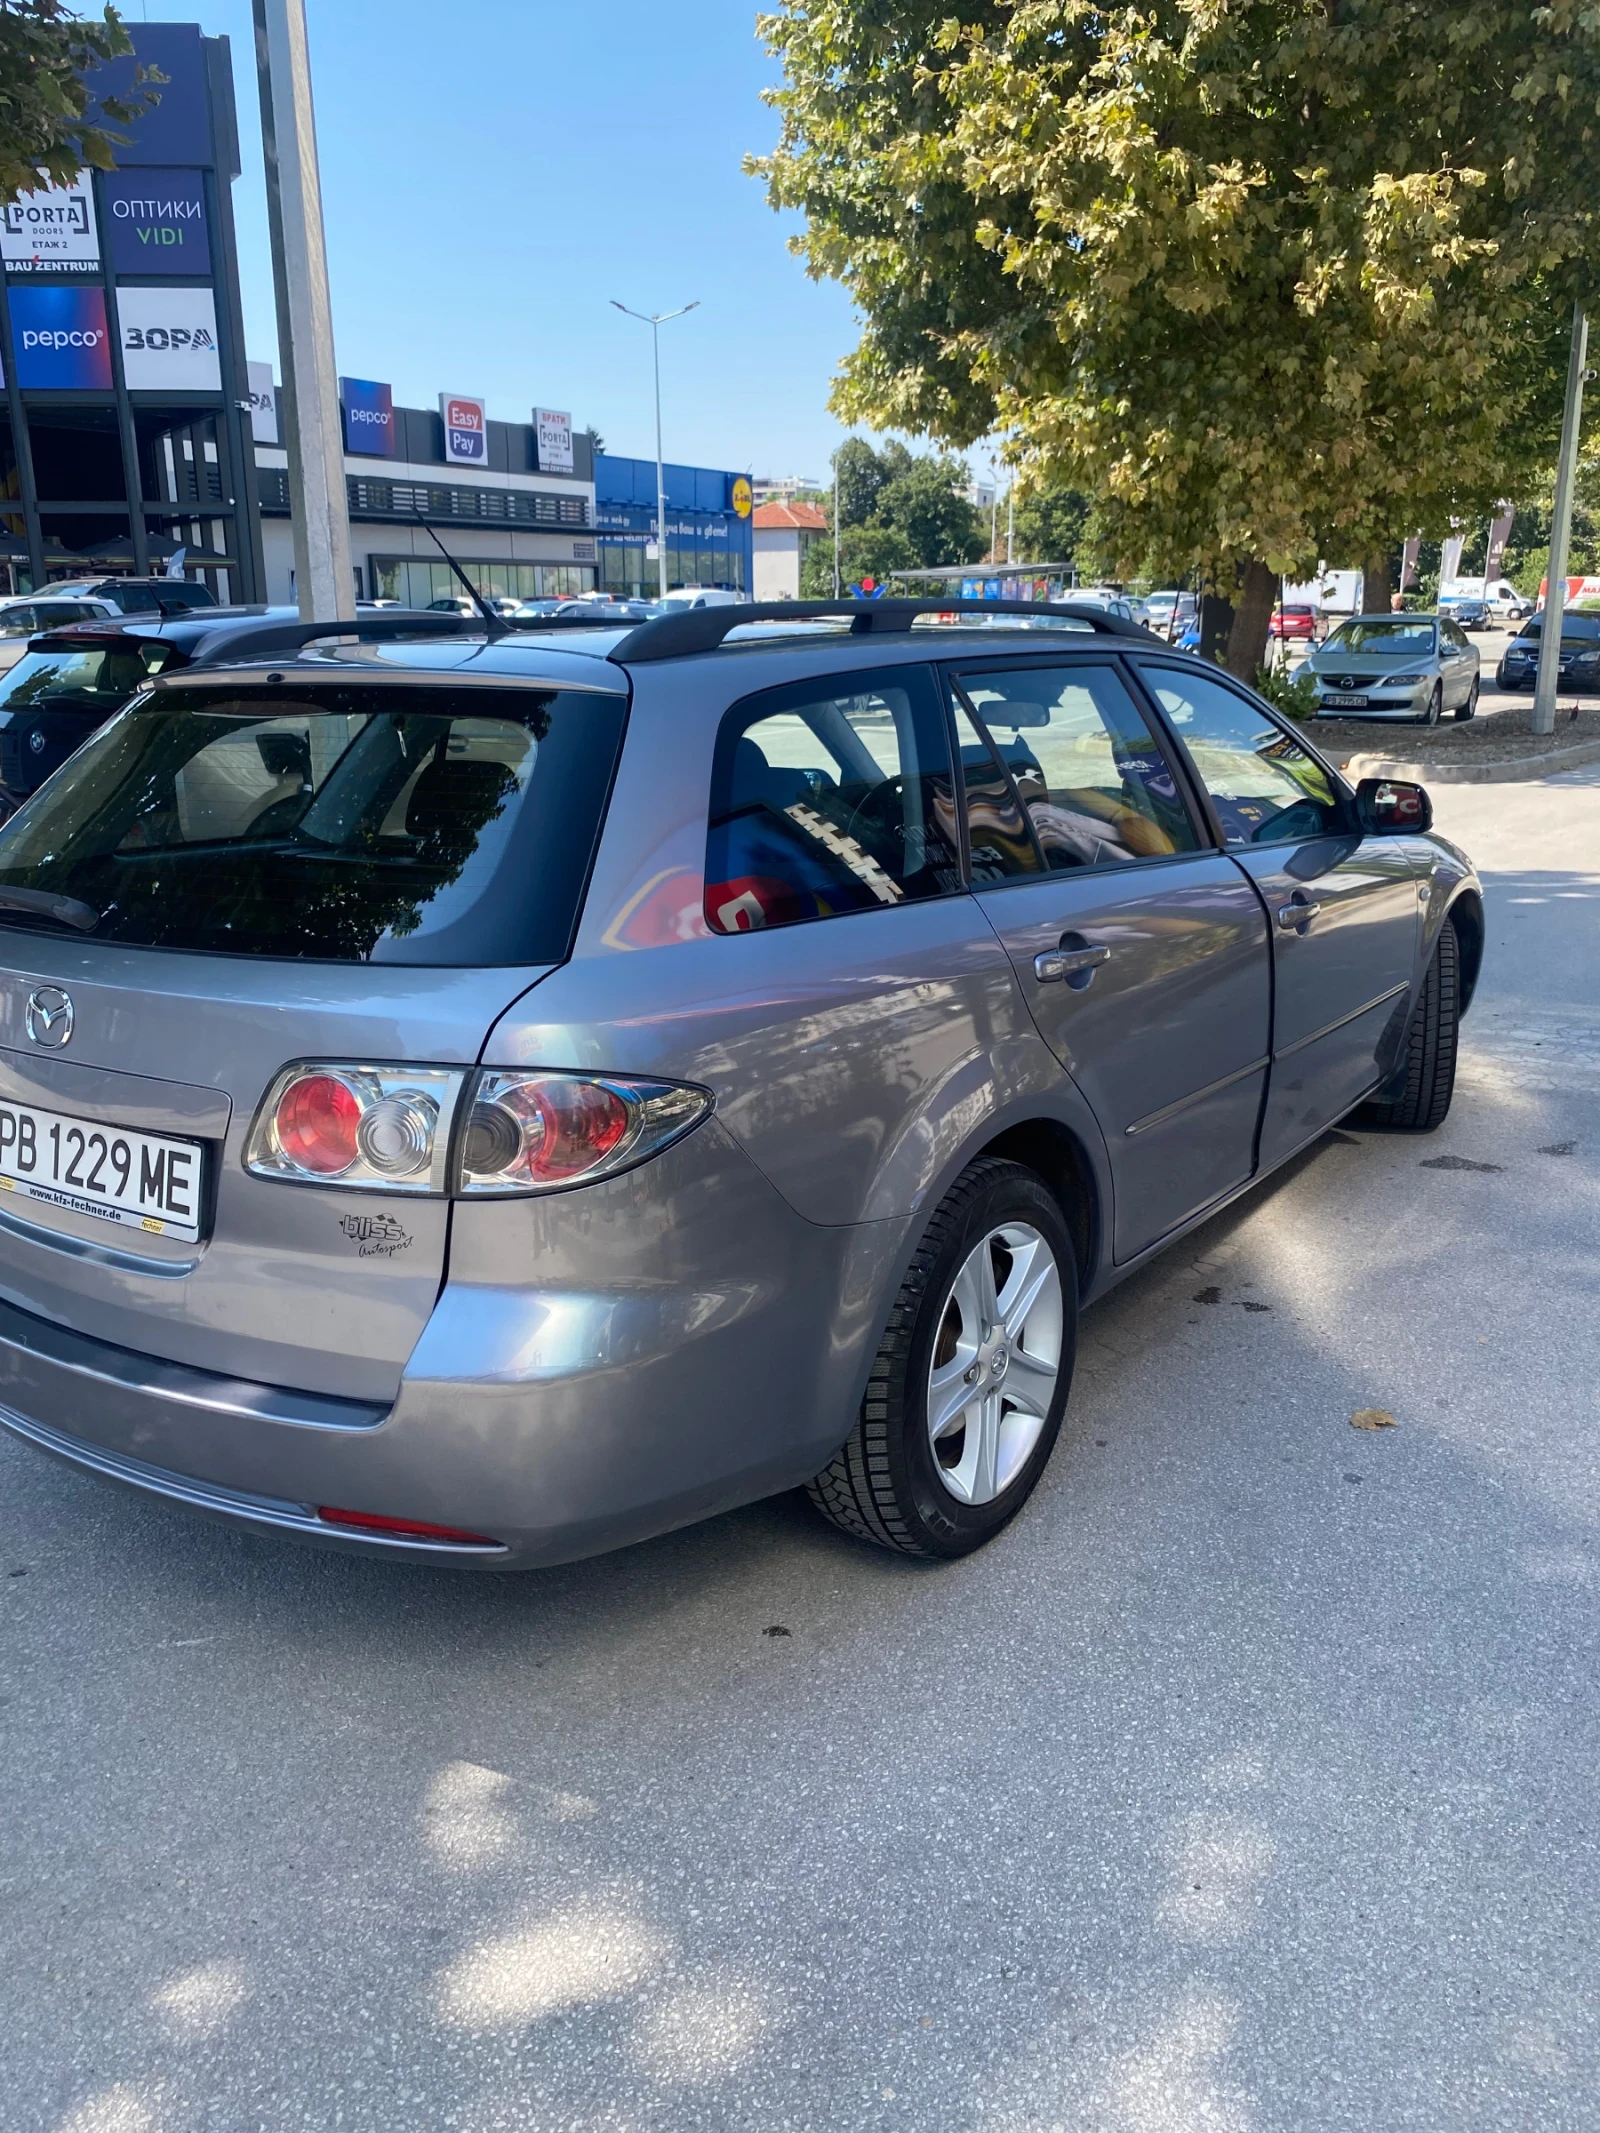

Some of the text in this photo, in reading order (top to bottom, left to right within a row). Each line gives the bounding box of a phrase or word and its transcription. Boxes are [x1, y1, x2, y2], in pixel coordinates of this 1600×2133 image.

[13, 207, 80, 223] PORTA
[113, 200, 201, 219] ОПТИКИ
[32, 227, 64, 235] DOORS
[136, 227, 183, 245] VIDI
[32, 241, 68, 249] ЕТАЖ 2
[5, 261, 99, 271] BAU ZENTRUM
[23, 330, 98, 350] pepco
[125, 328, 216, 350] ЗОРА
[351, 408, 388, 425] pepco
[452, 407, 479, 430] Easy
[453, 432, 474, 454] Pay
[543, 431, 567, 444] PORTA
[0, 1109, 192, 1216] PB 1229 ME
[29, 1187, 122, 1221] www.kfz-fechner.de
[141, 1219, 163, 1233] fechner
[343, 1214, 403, 1242] bliss
[359, 1236, 414, 1258] Autosport
